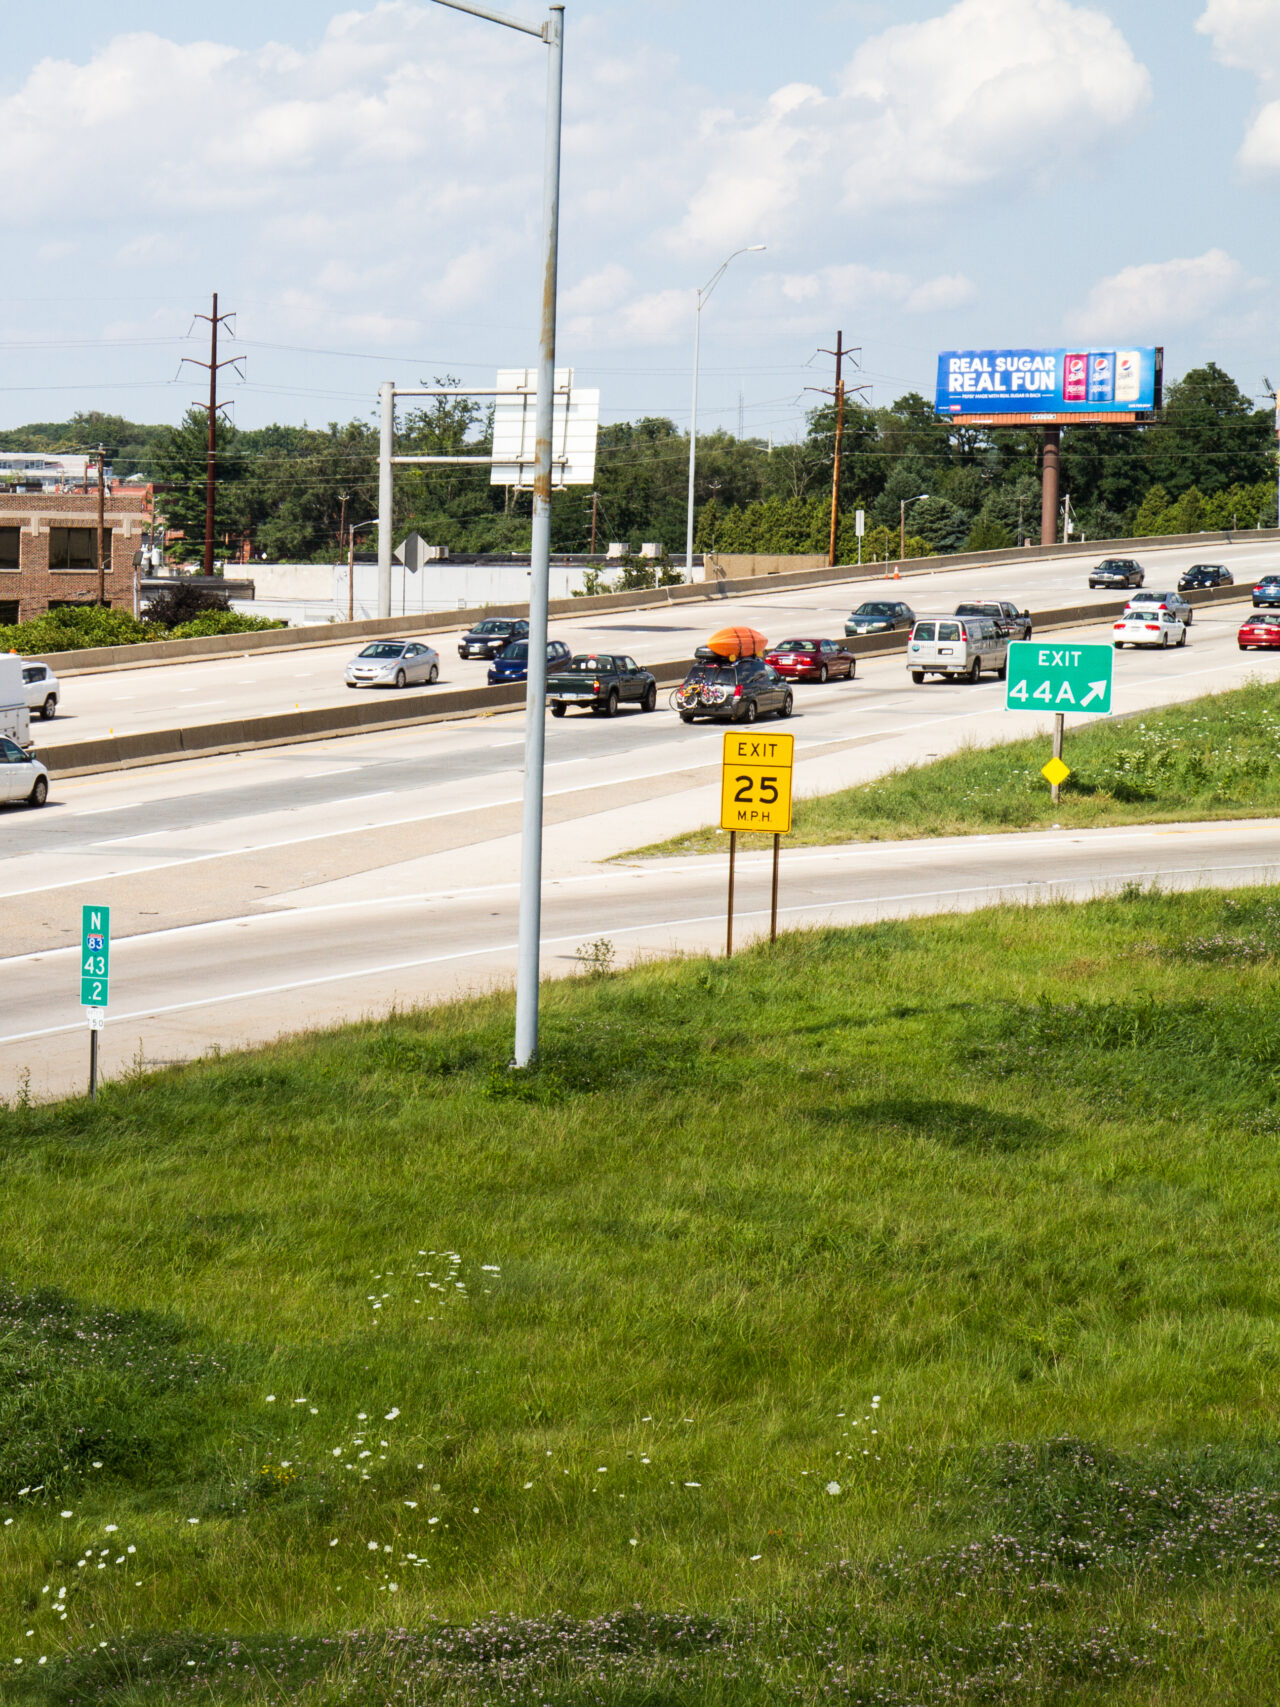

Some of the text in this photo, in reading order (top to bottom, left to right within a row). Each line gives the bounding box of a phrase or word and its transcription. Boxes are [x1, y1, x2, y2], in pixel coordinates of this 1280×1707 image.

[950, 357, 1056, 372] REAL SUGAR
[949, 373, 1006, 392] REAL
[1012, 372, 1055, 391] FUN
[1038, 650, 1082, 666] EXIT
[1009, 680, 1075, 703] 44A
[738, 743, 778, 757] EXIT
[734, 775, 778, 804] 25
[91, 912, 101, 930] N
[88, 938, 103, 949] 83
[84, 956, 105, 974] 43
[88, 982, 102, 1000] .2
